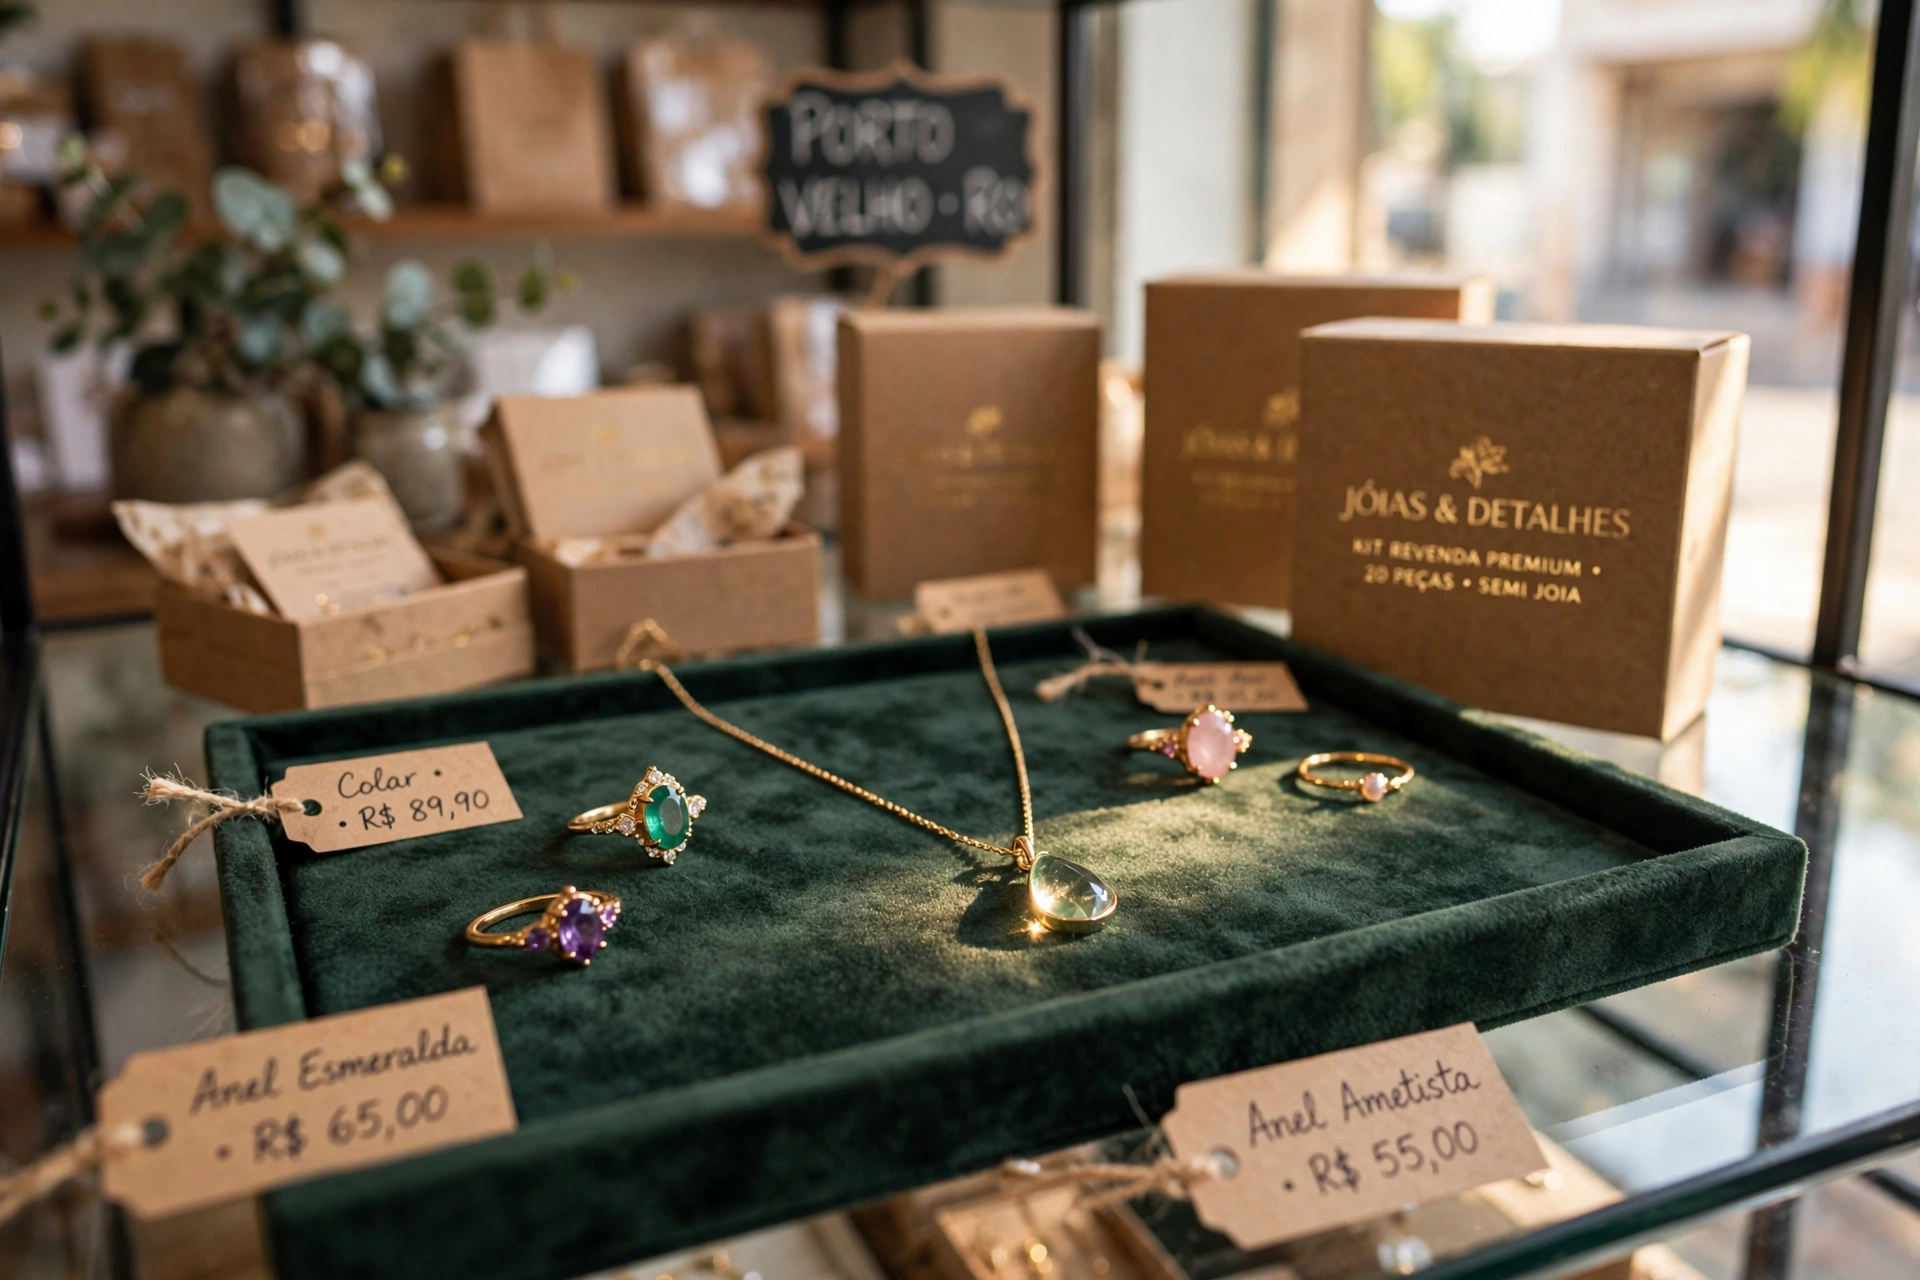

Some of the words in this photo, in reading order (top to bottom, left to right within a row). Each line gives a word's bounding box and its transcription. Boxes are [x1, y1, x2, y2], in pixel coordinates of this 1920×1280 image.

[790, 91, 955, 167] PORTO
[777, 173, 934, 238] VELHO
[1339, 478, 1428, 522] JÓIAS
[1434, 494, 1459, 524] &
[1467, 496, 1631, 539] DETALHES
[1352, 537, 1384, 556] KIT
[1389, 541, 1481, 567] REVENDA
[1486, 551, 1582, 577] PREMIUM
[1393, 567, 1455, 593] PEÇAS
[1478, 576, 1528, 598] SEMI
[1533, 583, 1582, 605] JOIA
[337, 767, 417, 799] Colar
[358, 803, 396, 831] R$
[409, 789, 490, 822] 89,90
[188, 1057, 283, 1116] Anel
[297, 1024, 478, 1092] Esmeralda
[252, 1114, 308, 1163] R$
[327, 1084, 450, 1147] 65,00
[1248, 1090, 1328, 1149] Anel
[1341, 1060, 1481, 1123] Ametista
[1308, 1146, 1361, 1194] R$
[1371, 1120, 1480, 1178] 55,00
